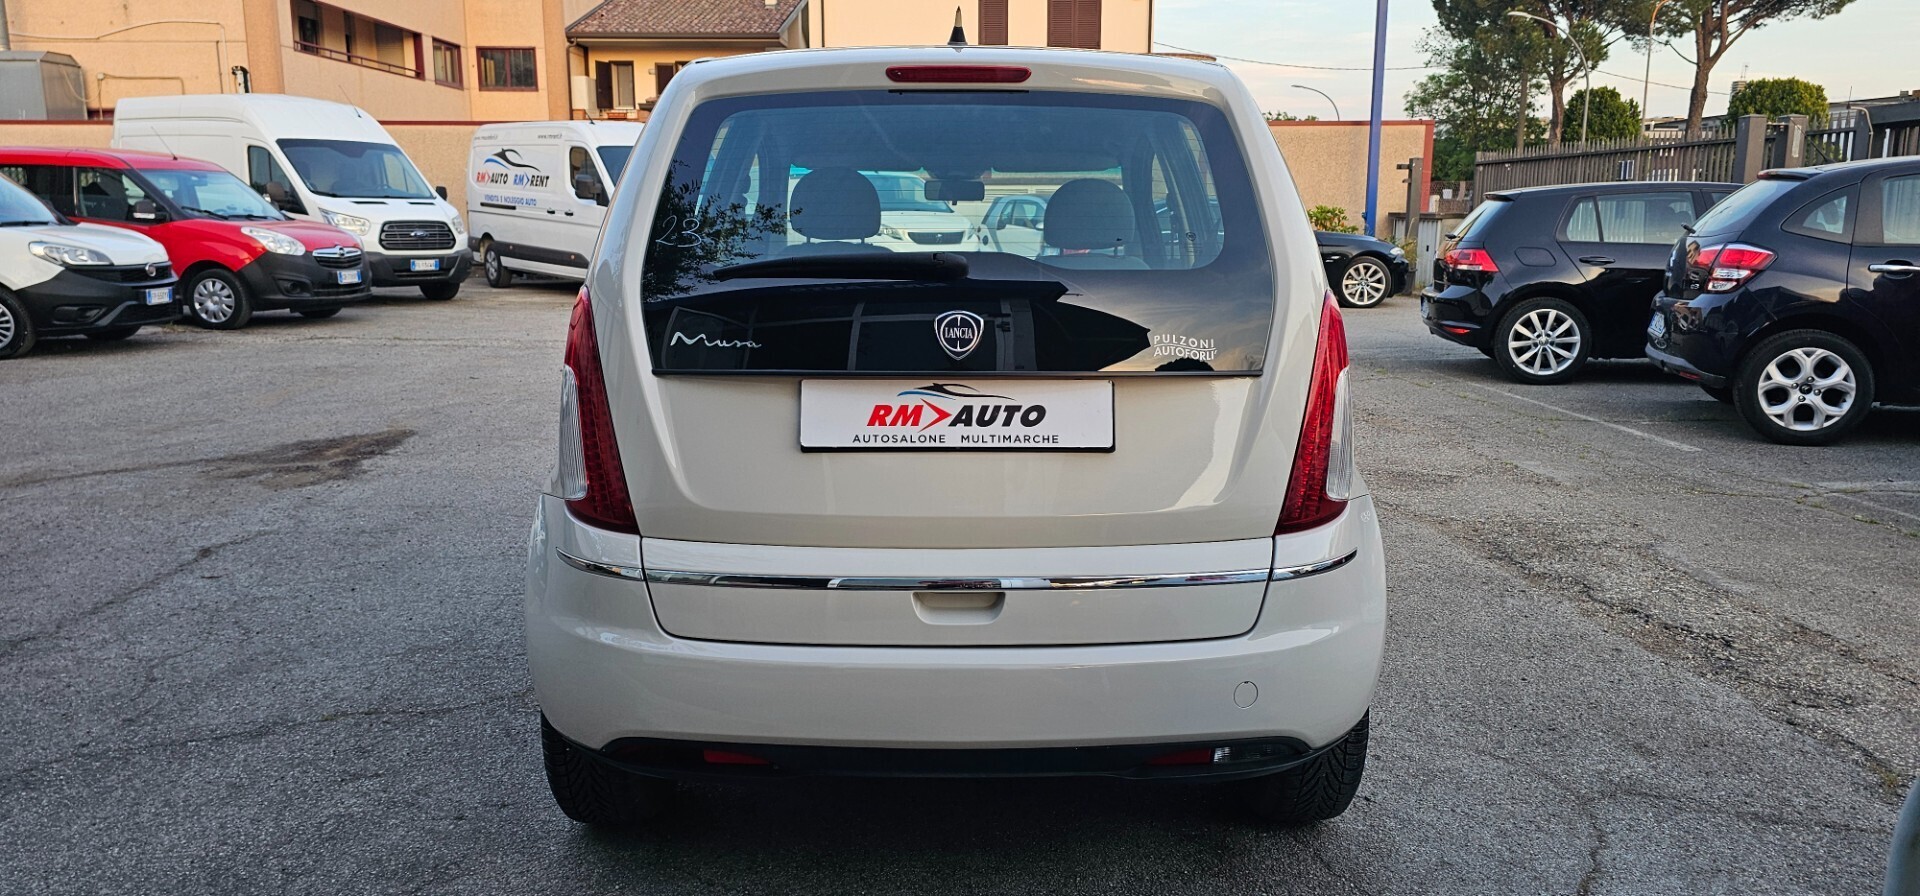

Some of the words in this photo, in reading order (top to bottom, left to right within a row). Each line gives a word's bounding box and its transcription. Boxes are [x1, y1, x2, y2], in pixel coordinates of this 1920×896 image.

[476, 172, 487, 183] RM
[490, 172, 509, 185] AUTO
[513, 173, 525, 186] RM
[530, 174, 550, 187] RENT
[525, 198, 537, 206] AUTO
[655, 215, 702, 248] 23
[670, 331, 762, 348] Musa
[945, 327, 973, 339] LANCIA
[1153, 334, 1215, 349] PULZONI
[948, 404, 1047, 428] AUTO
[852, 434, 946, 444] AUTOSALONE
[960, 434, 1060, 444] MULTIMARCHE
